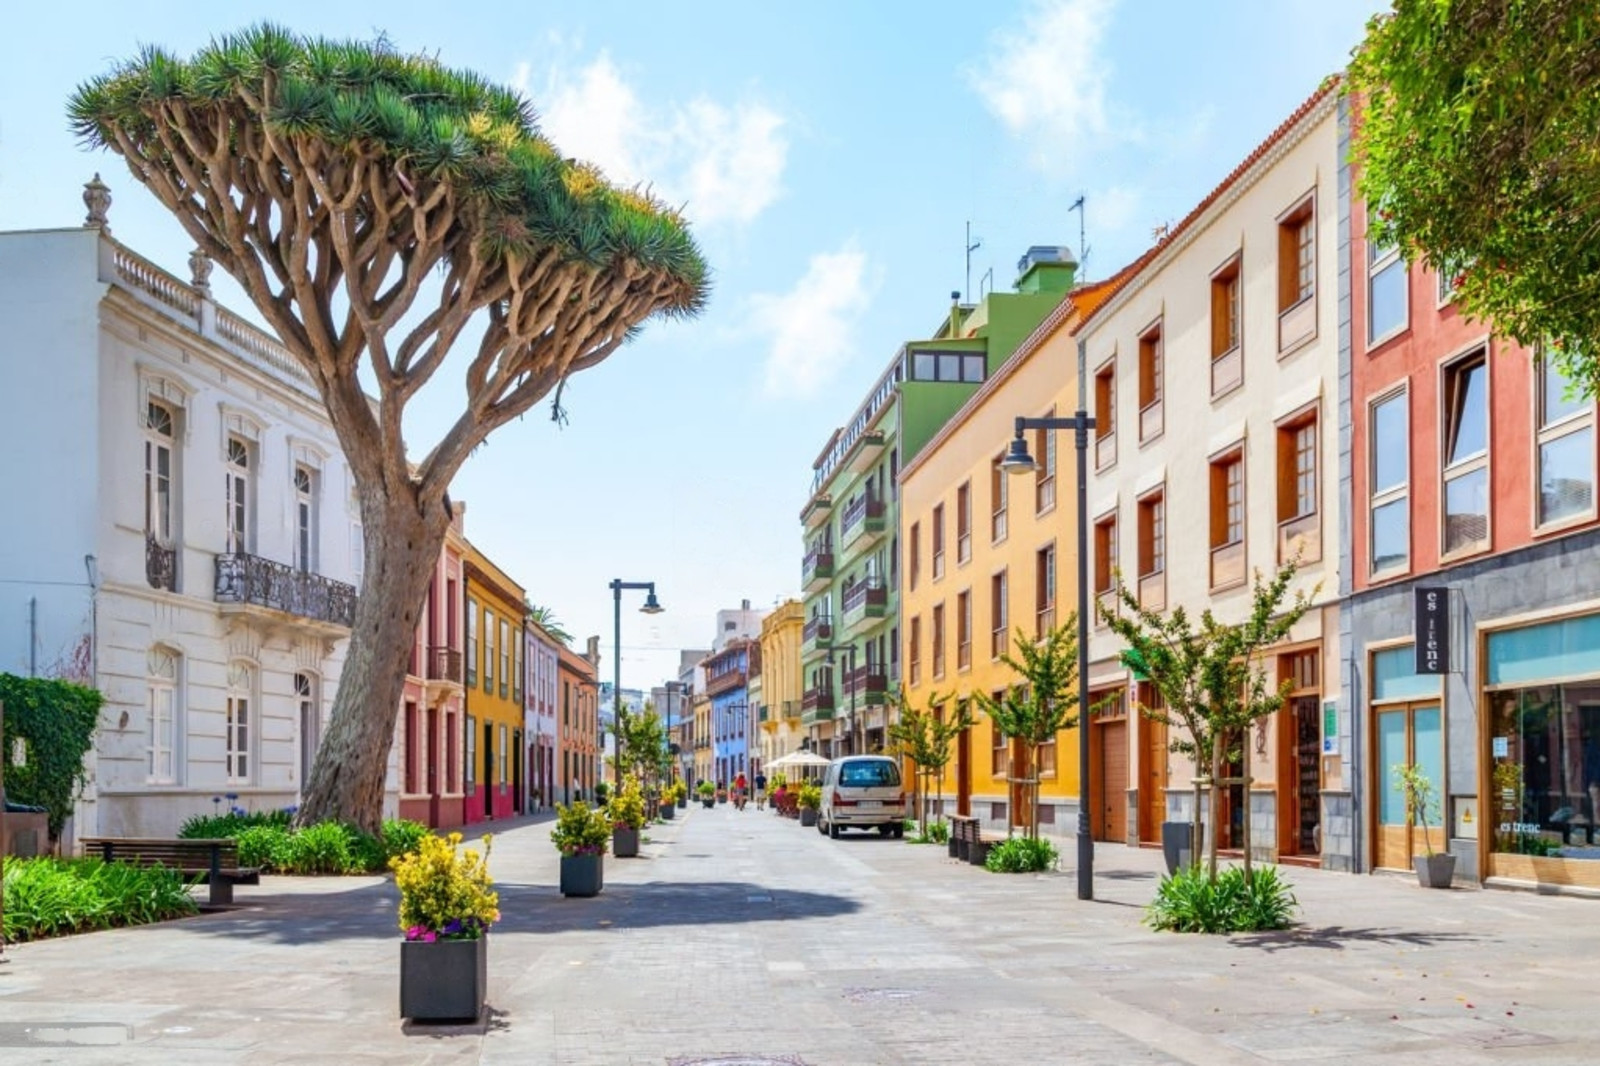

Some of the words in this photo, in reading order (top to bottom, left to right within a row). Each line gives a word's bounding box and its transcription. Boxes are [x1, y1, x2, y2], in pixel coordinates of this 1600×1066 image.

[1426, 592, 1438, 612] es
[1500, 822, 1511, 832] es
[1512, 821, 1541, 834] trenc
